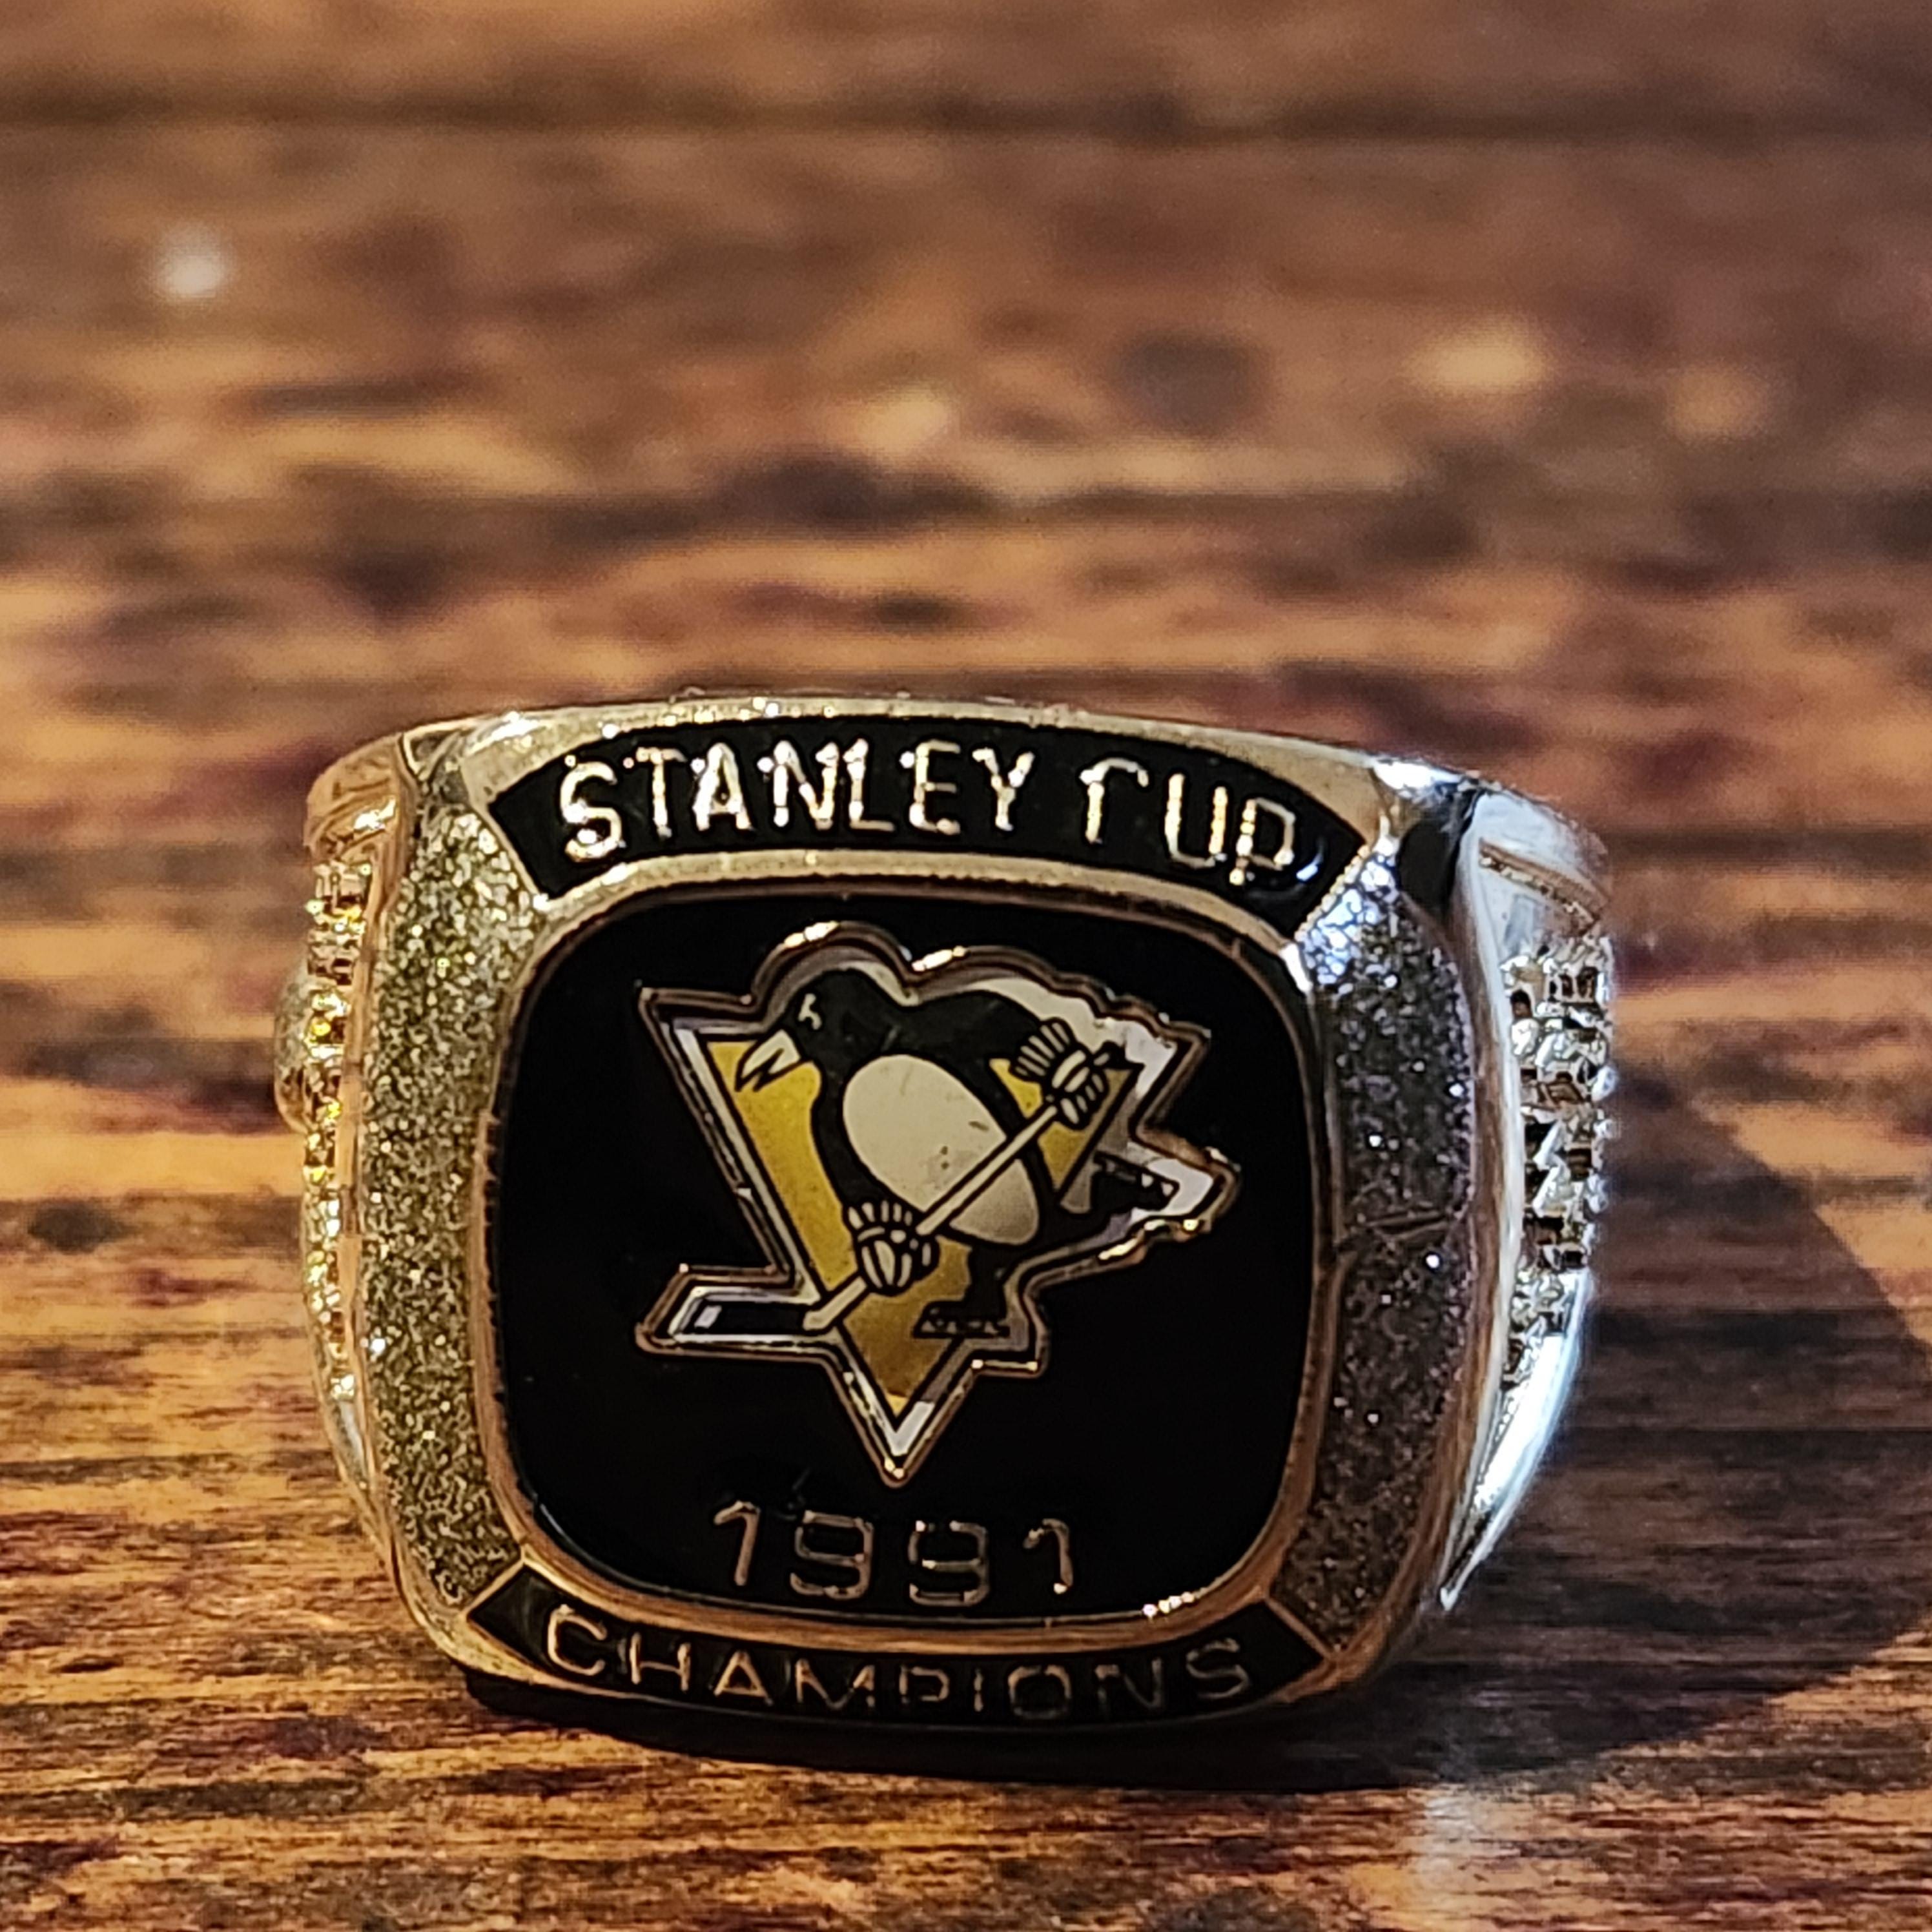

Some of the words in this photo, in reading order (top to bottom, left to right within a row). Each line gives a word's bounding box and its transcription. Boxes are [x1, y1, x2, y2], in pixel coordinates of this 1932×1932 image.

[558, 738, 1034, 863] STANLEY
[714, 1499, 1074, 1605] 1991
[547, 1603, 1251, 1721] CHAMPIONS
